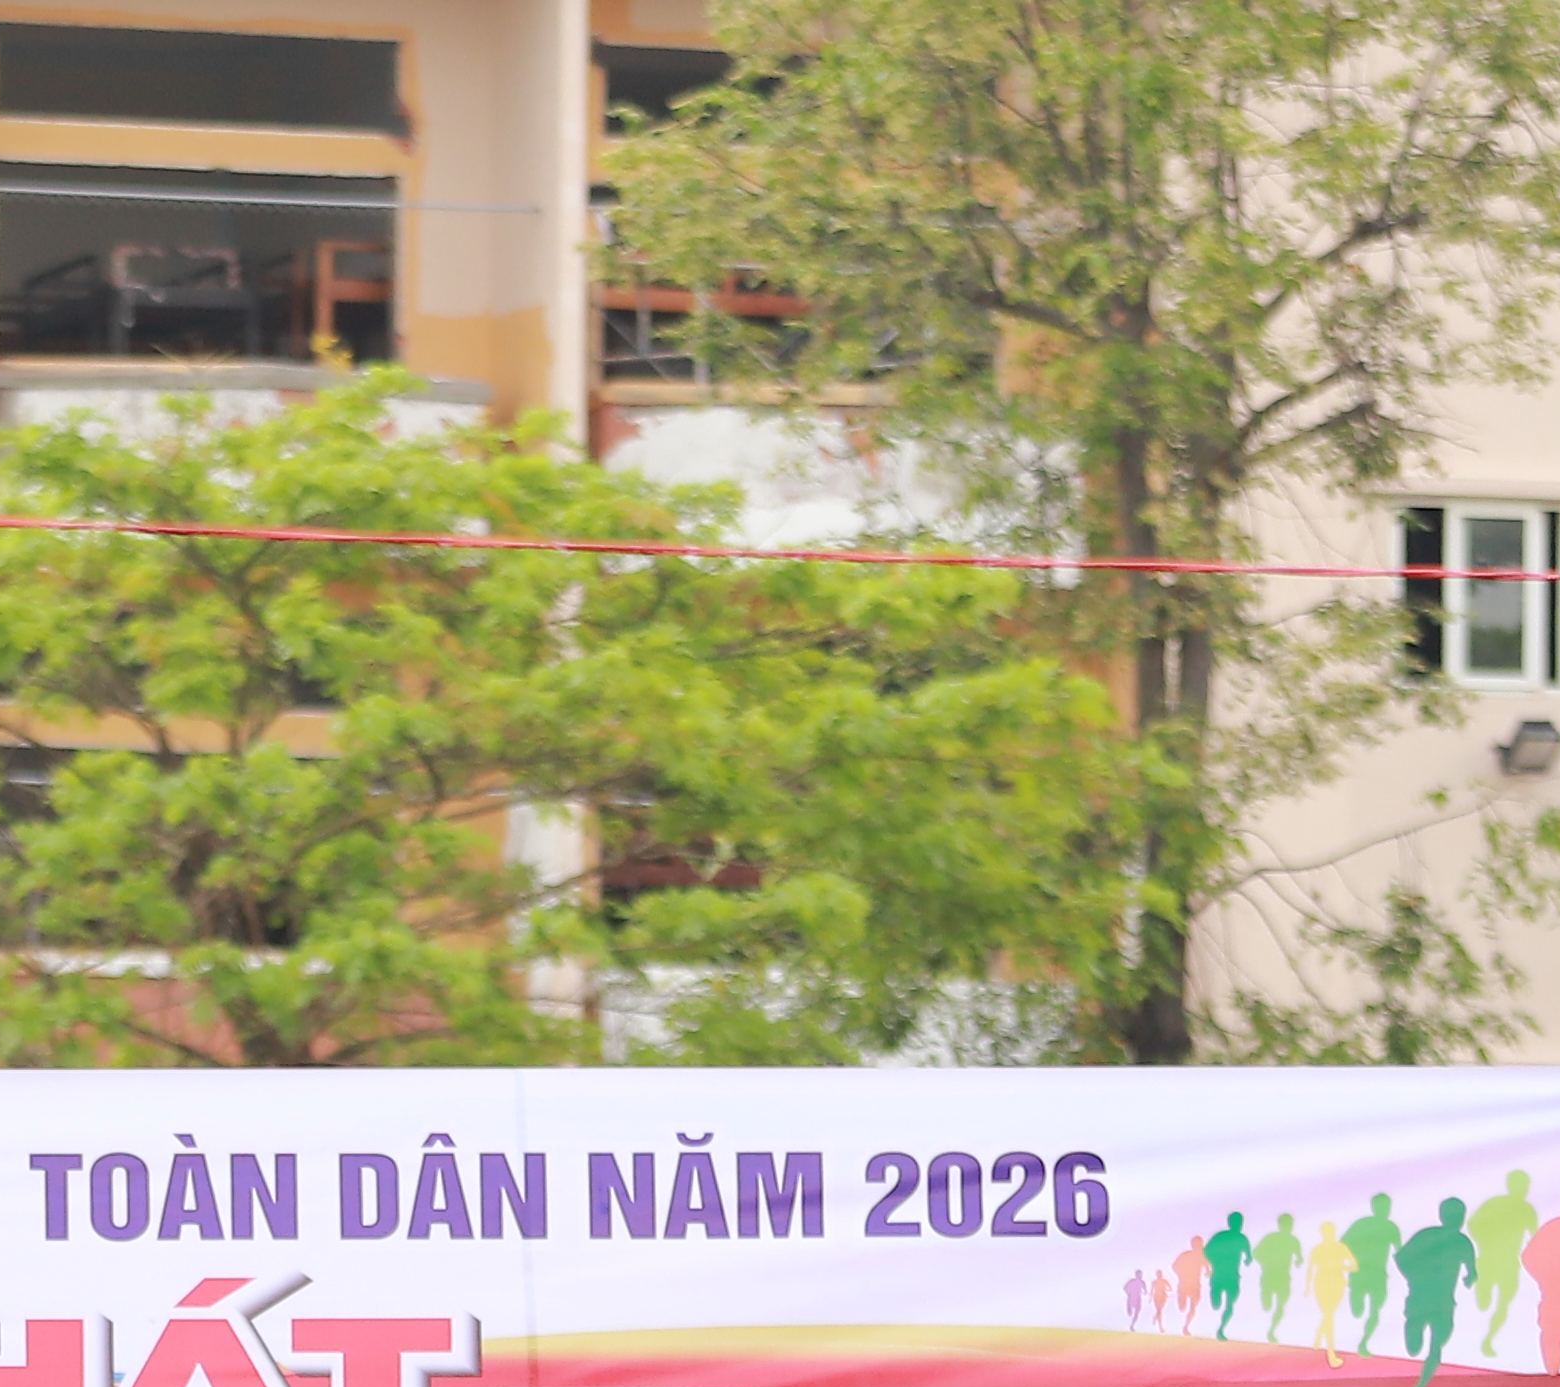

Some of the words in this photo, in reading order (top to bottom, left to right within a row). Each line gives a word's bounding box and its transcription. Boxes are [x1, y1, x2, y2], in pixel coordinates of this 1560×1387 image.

[29, 1132, 299, 1242] TOÀN
[339, 1131, 549, 1240] DÂN
[588, 1131, 825, 1240] NĂM
[864, 1150, 1110, 1240] 2026
